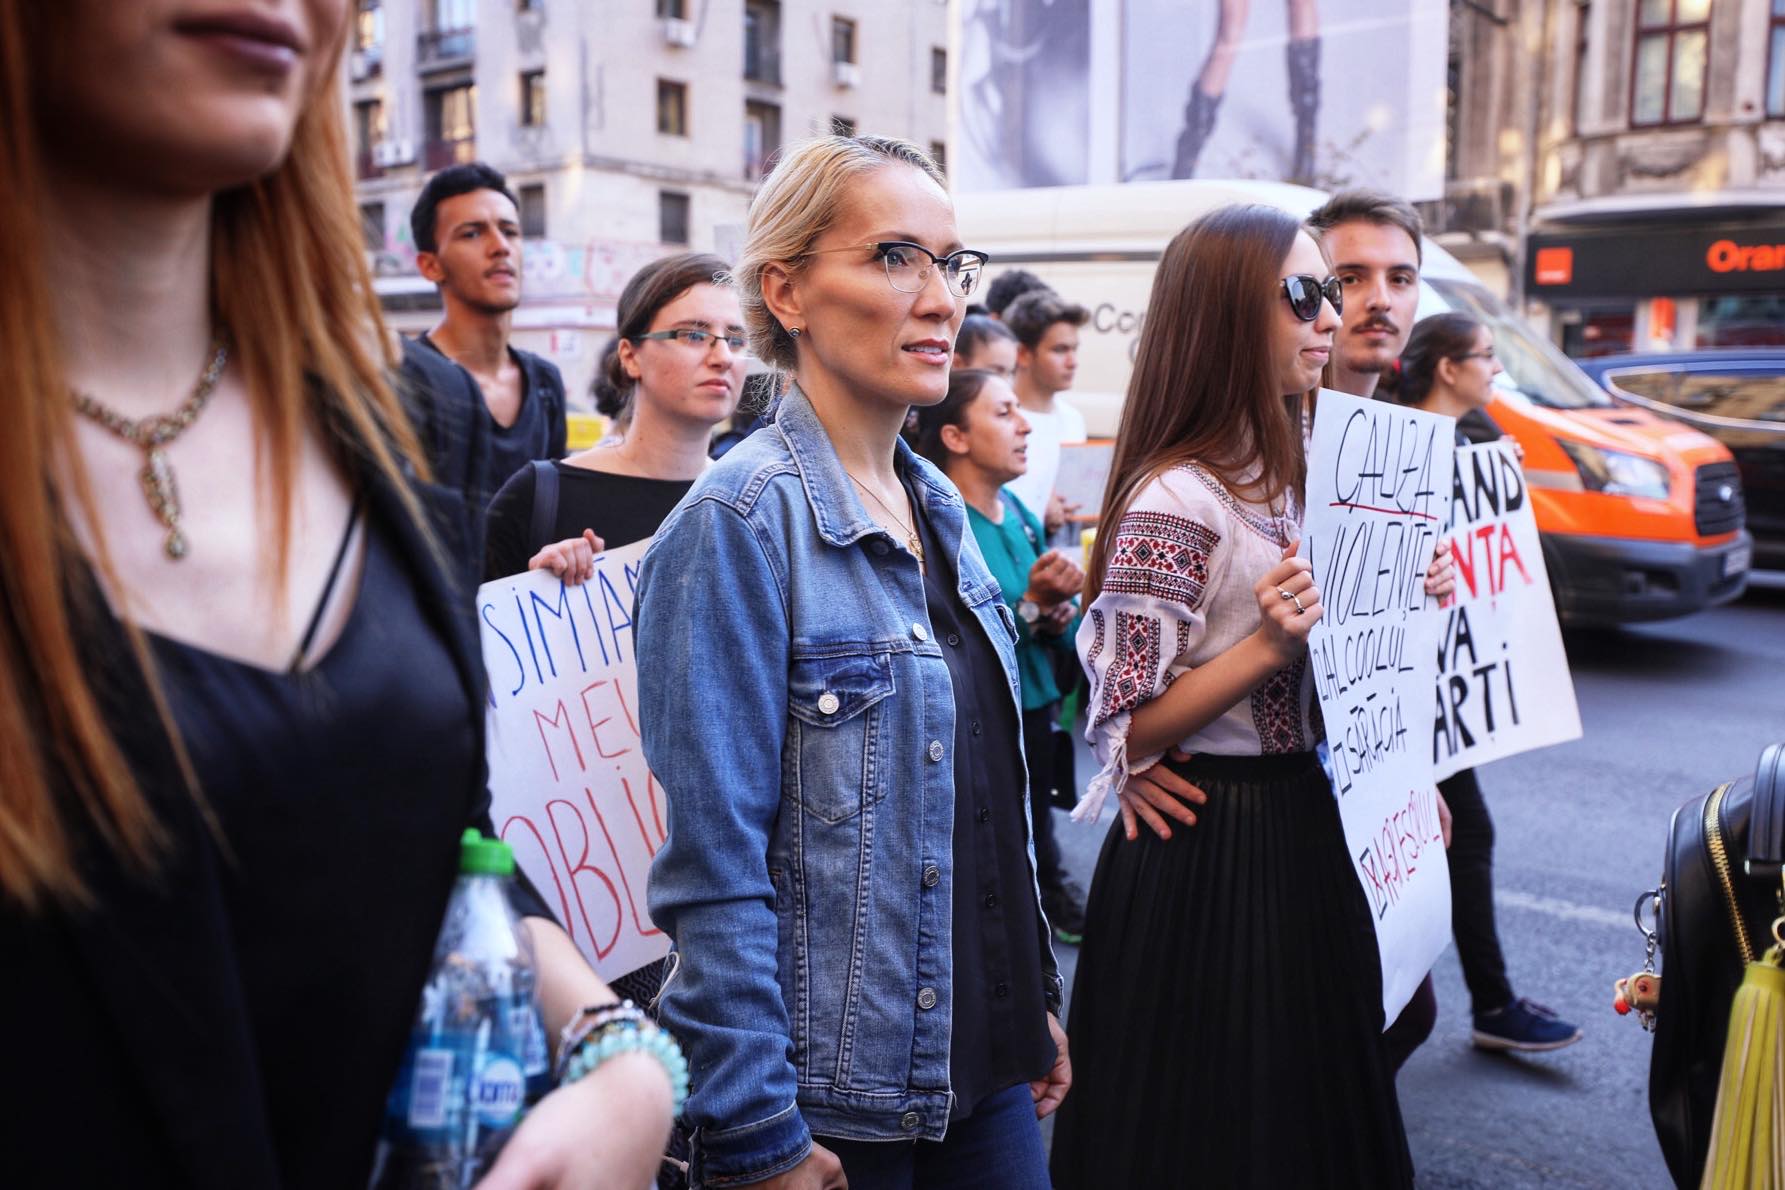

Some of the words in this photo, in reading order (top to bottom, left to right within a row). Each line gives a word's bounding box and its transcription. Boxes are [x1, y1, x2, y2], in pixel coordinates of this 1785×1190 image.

[1093, 303, 1146, 333] Co
[1452, 449, 1524, 527] AND
[483, 557, 641, 698] SIMTA
